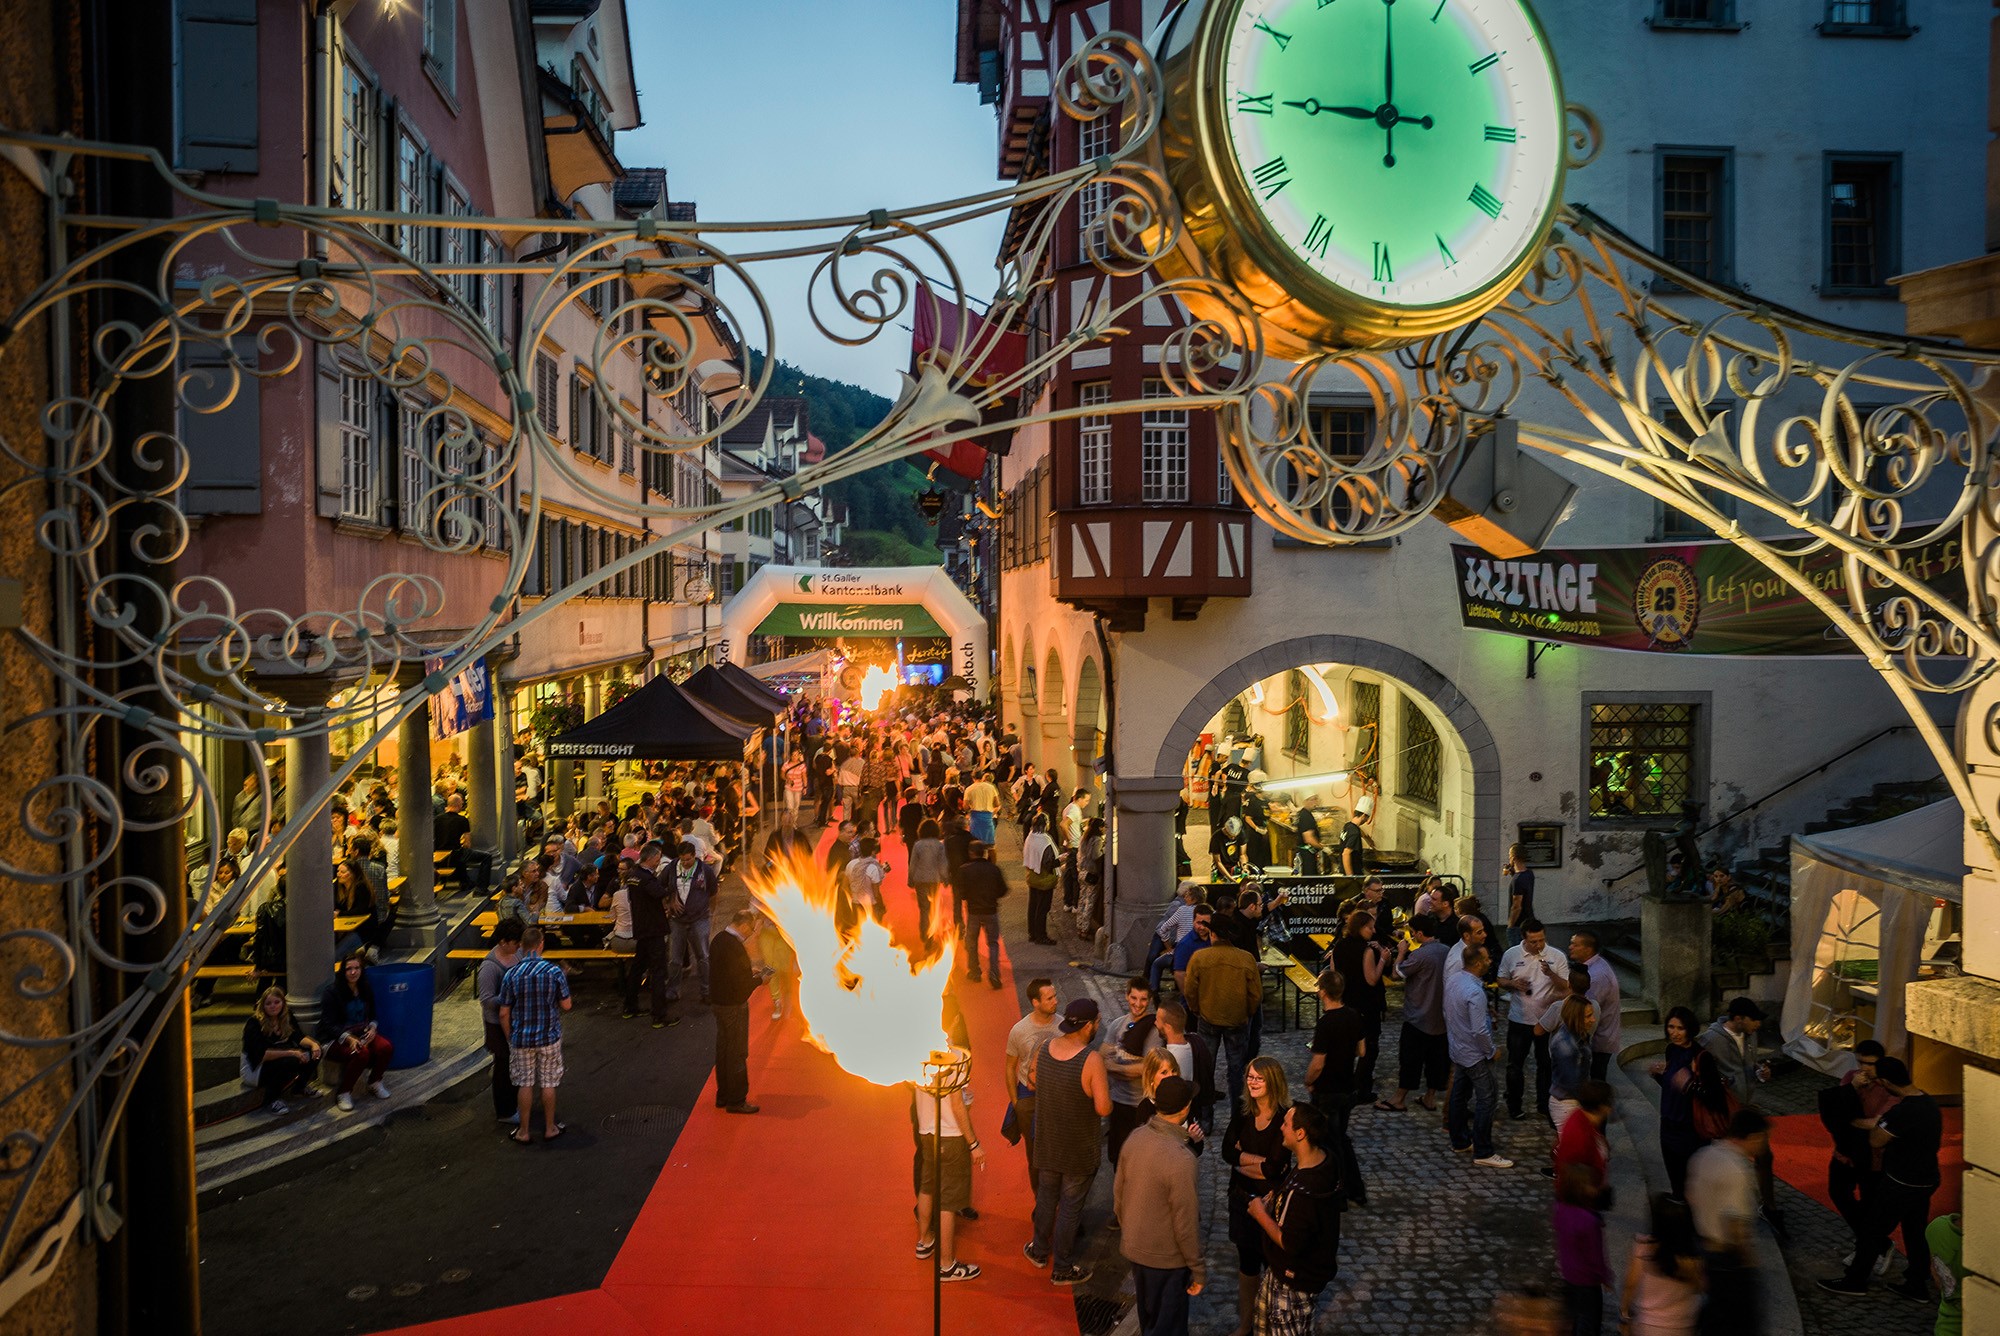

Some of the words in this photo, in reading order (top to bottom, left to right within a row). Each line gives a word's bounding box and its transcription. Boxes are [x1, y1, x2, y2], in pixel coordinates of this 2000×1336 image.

[1253, 14, 1293, 52] X
[1467, 51, 1500, 76] II
[1237, 91, 1274, 117] IX
[1484, 123, 1517, 144] III
[1252, 156, 1293, 200] VIII
[1467, 182, 1504, 220] IIII
[1302, 212, 1335, 259] VII
[1372, 241, 1394, 282] VI
[1435, 232, 1458, 270] V
[821, 584, 903, 596] Kantonalbank
[1464, 557, 1598, 614] JAZZTAGE
[1706, 574, 1736, 605] Let
[1740, 575, 1787, 614] your
[1654, 587, 1676, 611] 25
[799, 611, 904, 631] Willkommen
[1578, 621, 1600, 637] 2013
[550, 742, 635, 756] PERFECTLIGHT
[1284, 894, 1325, 907] gentur
[1289, 917, 1301, 925] DIE
[1290, 926, 1304, 934] AUS
[1305, 926, 1321, 934] DEM
